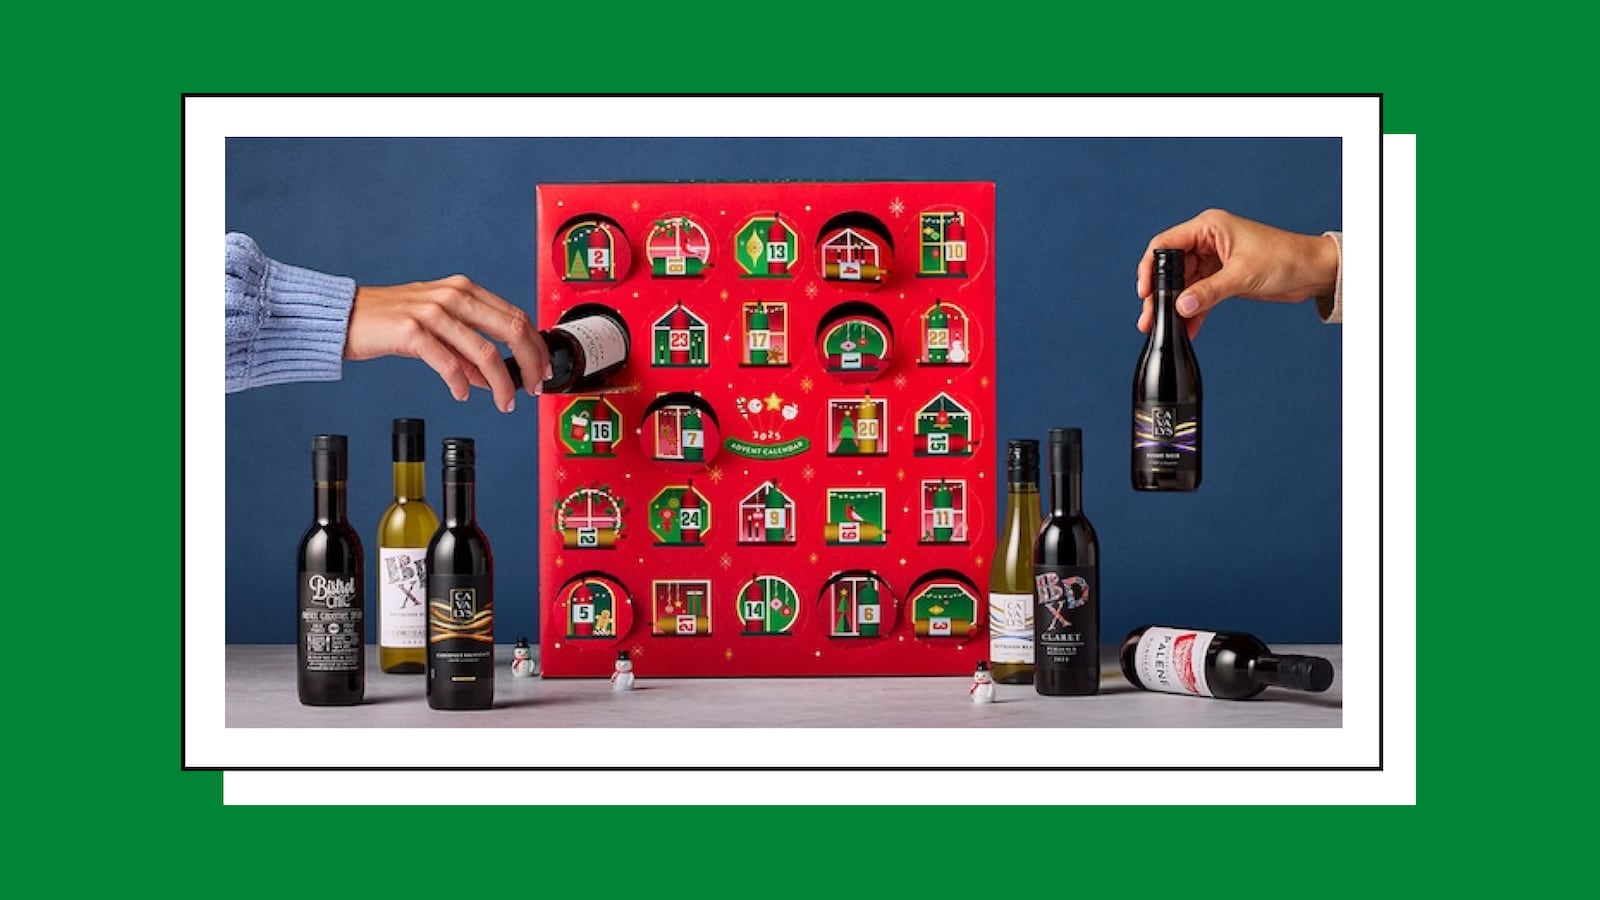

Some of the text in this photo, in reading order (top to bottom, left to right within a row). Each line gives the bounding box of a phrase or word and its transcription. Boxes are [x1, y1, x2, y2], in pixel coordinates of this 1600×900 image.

[594, 250, 604, 264] 2
[770, 244, 785, 260] 13
[947, 244, 963, 259] 10
[667, 258, 683, 272] 18
[844, 266, 858, 274] 4
[672, 332, 688, 347] 23
[752, 332, 767, 347] 17
[930, 332, 946, 346] 22
[594, 424, 609, 438] 16
[752, 430, 781, 441] 2025
[859, 423, 876, 436] 20
[688, 433, 696, 445] 7
[930, 436, 946, 451] 15
[730, 441, 804, 456] ADVENT CALENDAR
[682, 511, 698, 526] 24
[770, 511, 780, 524] 9
[936, 511, 949, 525] 11
[580, 529, 596, 545] 12
[842, 526, 857, 538] 19
[579, 606, 588, 619] 5
[747, 603, 762, 617] 14
[864, 607, 873, 620] 6
[679, 617, 694, 632] 21
[933, 622, 947, 630] 3
[1041, 633, 1081, 641] CLARET
